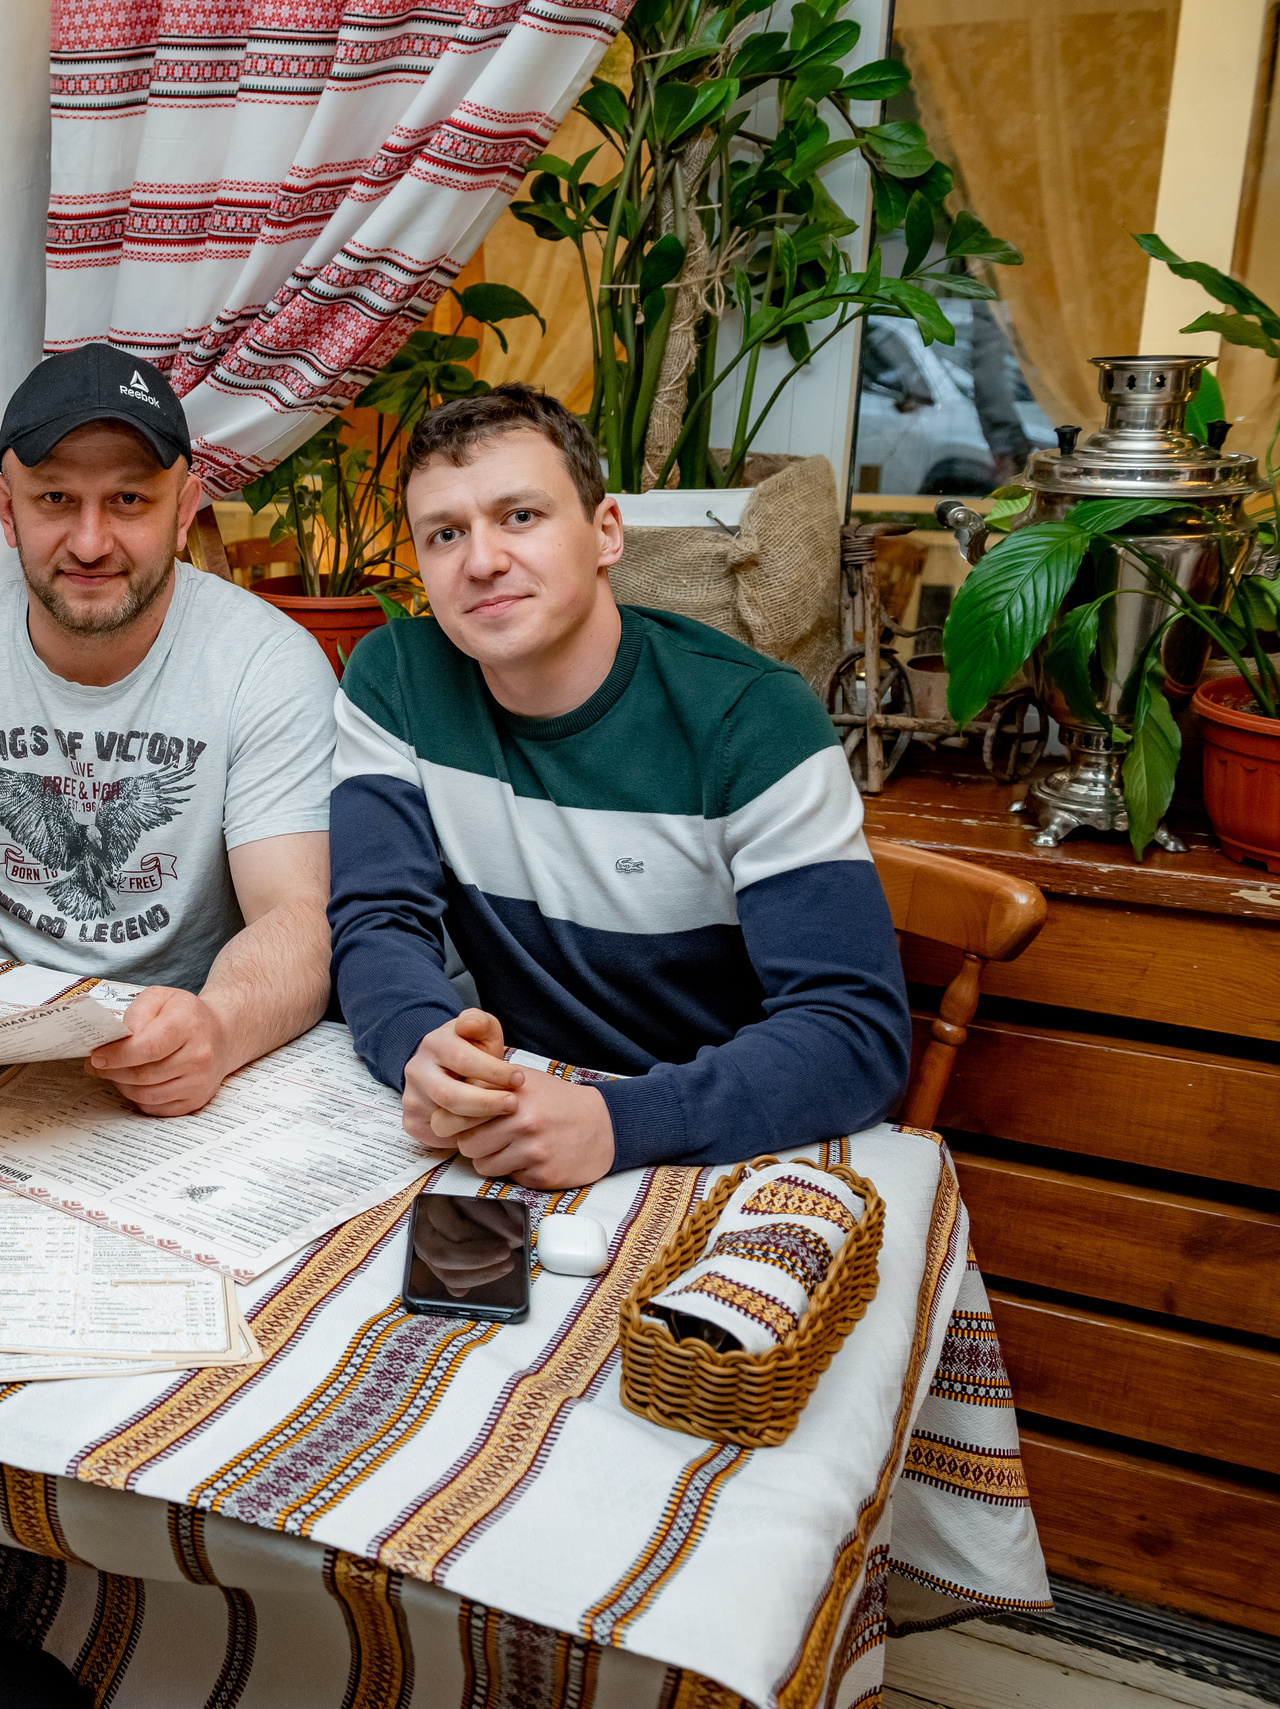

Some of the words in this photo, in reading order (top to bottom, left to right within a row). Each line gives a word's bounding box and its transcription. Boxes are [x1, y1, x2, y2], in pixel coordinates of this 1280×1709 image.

[119, 384, 161, 409] Reebok
[54, 728, 84, 761] OF
[94, 730, 207, 769] VICTORY
[70, 760, 95, 778] LIVE
[42, 775, 78, 798] FREE
[78, 780, 89, 800] &
[11, 864, 41, 881] BORN
[128, 874, 158, 890] FREE
[78, 903, 171, 944] LEGEND
[29, 1005, 71, 1020] КАРТА
